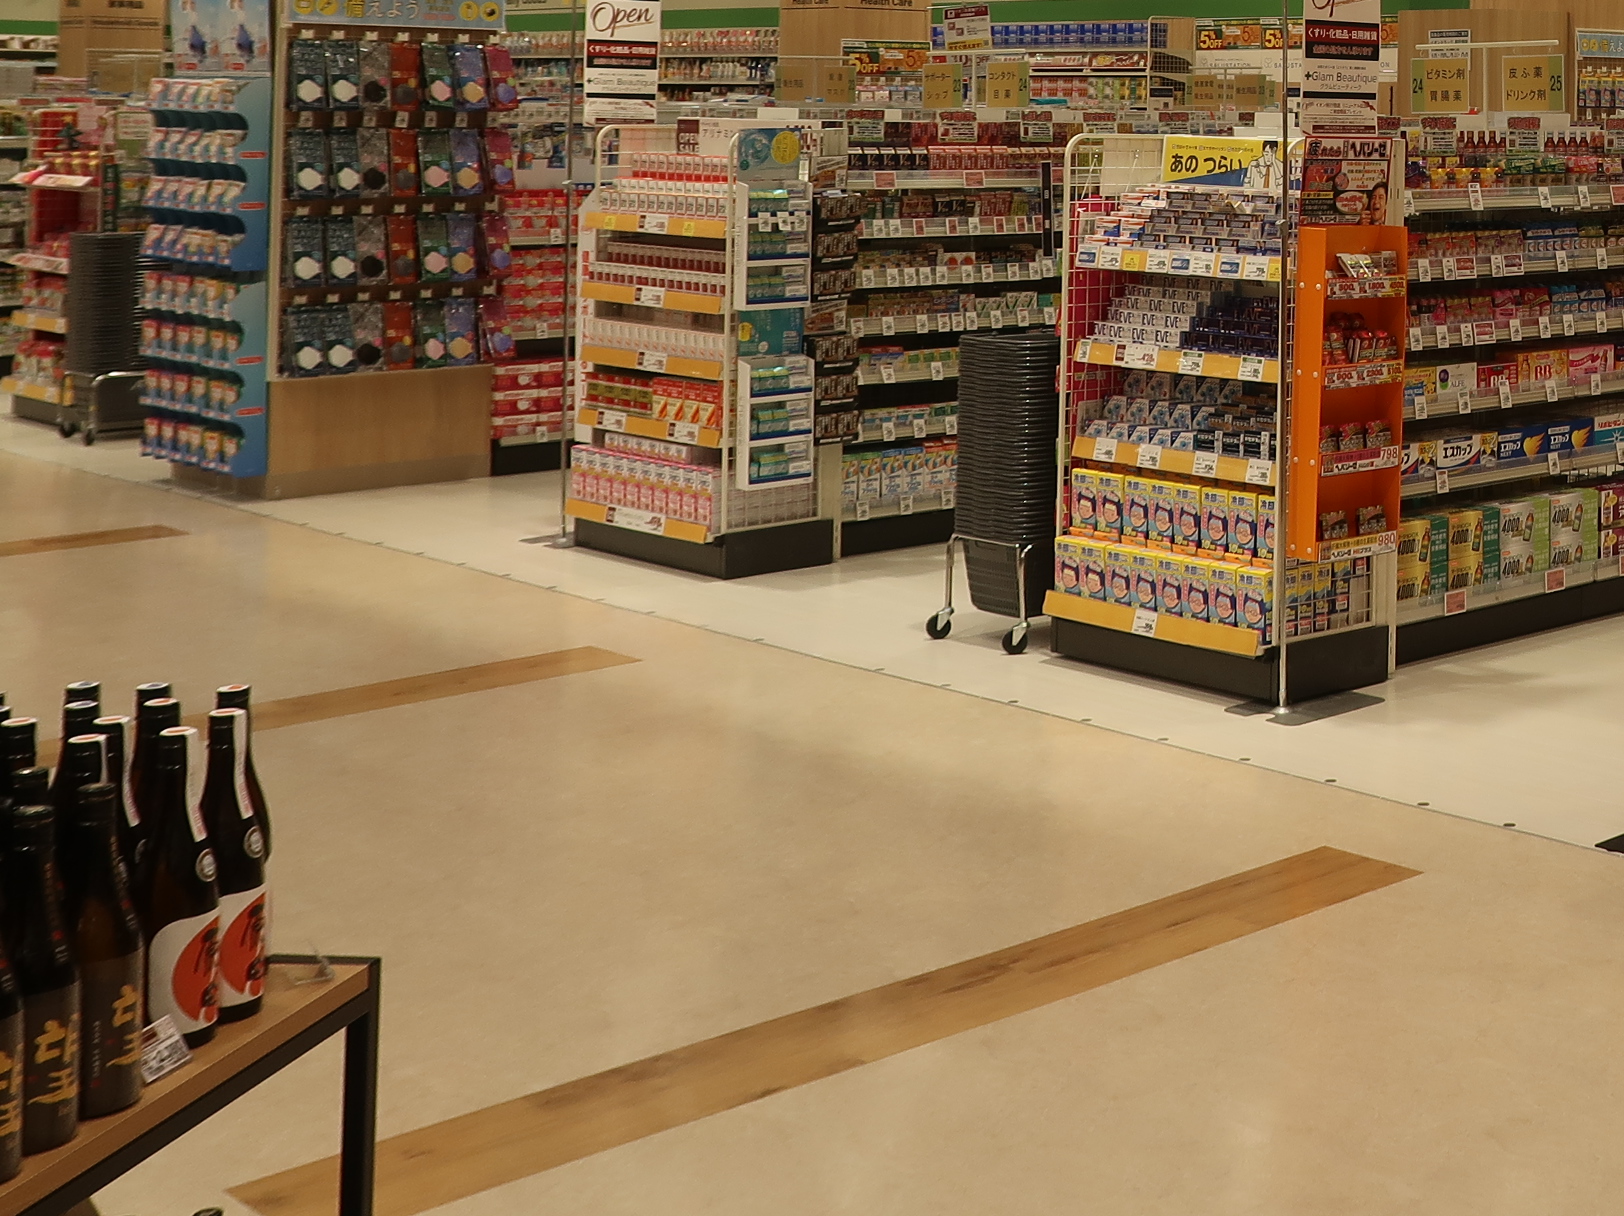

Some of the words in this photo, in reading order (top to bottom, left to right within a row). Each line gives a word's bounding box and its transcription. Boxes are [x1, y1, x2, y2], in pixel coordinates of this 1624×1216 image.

[590, 2, 654, 37] Open
[988, 72, 1017, 80] コンタクト
[1312, 72, 1334, 81] Glam
[1336, 72, 1377, 84] Beautique
[1426, 68, 1465, 80] ビタミン剤
[1019, 78, 1027, 92] 24
[1413, 78, 1423, 94] 24
[1550, 74, 1562, 91] 25
[1506, 89, 1546, 101] ドリンク剤
[1170, 153, 1199, 173] あの
[1381, 447, 1398, 460] 798
[1442, 443, 1473, 458] エスカップ
[1378, 533, 1395, 545] 980
